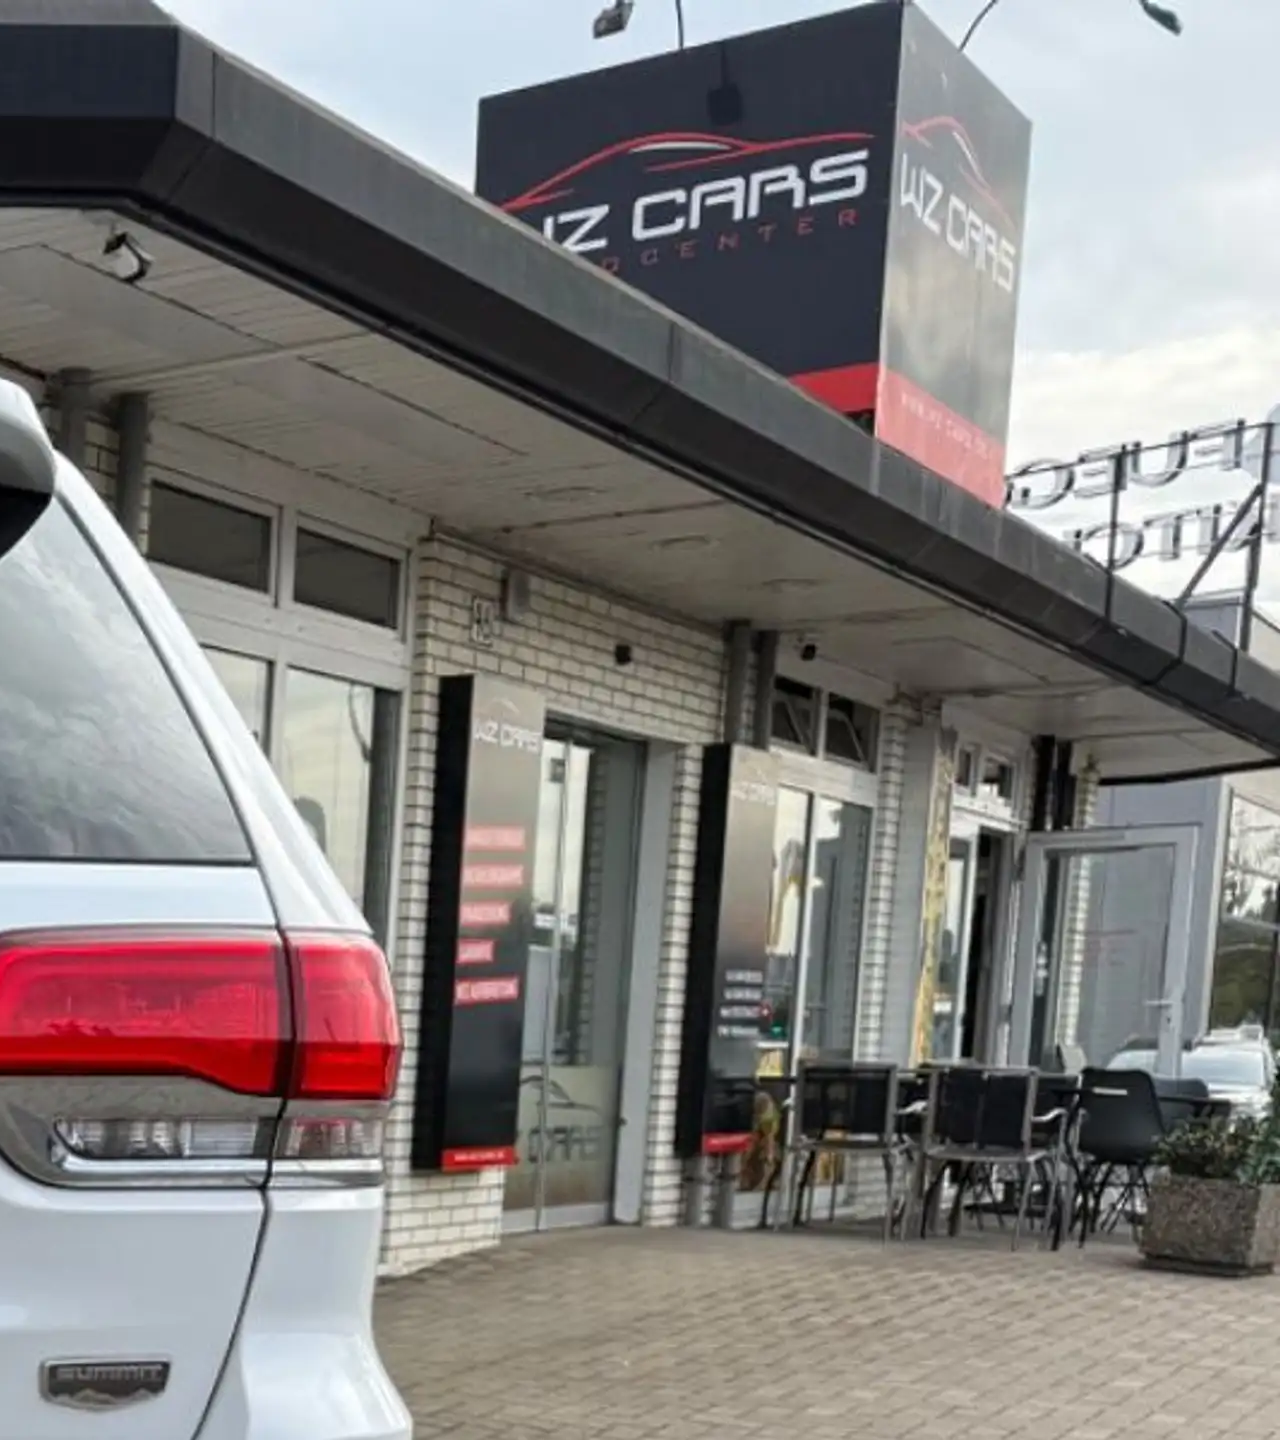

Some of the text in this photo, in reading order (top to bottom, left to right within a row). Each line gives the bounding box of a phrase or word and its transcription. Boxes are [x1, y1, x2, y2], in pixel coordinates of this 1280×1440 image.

[542, 149, 870, 254] Z CARS
[900, 153, 1016, 293] WZ CARS
